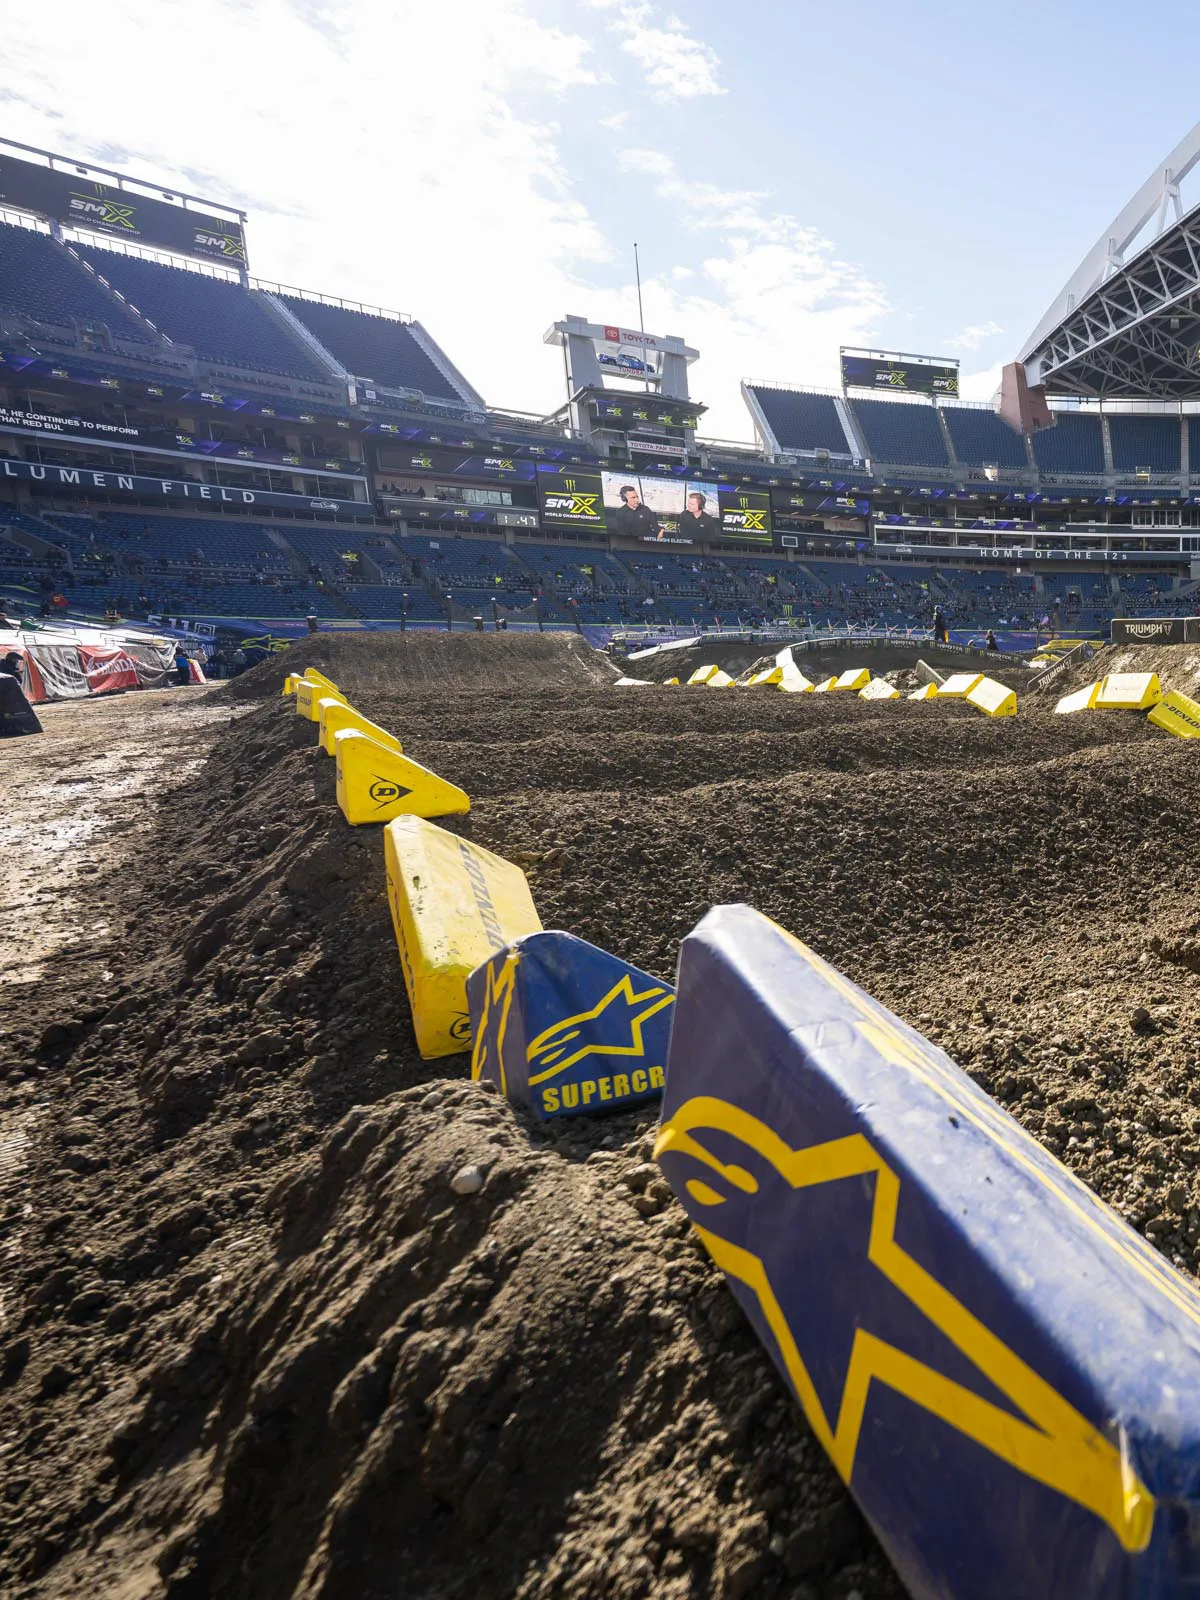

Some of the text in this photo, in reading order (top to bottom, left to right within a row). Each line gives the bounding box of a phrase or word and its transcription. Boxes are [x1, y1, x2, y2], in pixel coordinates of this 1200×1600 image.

[69, 199, 135, 229] SMX
[194, 234, 243, 258] SMX
[622, 332, 656, 346] TOYOTA
[875, 372, 907, 386] SMX
[11, 410, 139, 436] HE CONTINUES TO PERFORM
[22, 419, 43, 429] RED
[44, 422, 64, 431] BUL
[483, 457, 514, 470] SMX
[4, 462, 256, 504] LUMEN FIELD
[545, 496, 597, 516] SMX
[545, 511, 601, 521] WORLD CHAMPIONSHIP
[723, 512, 766, 530] SMX
[980, 549, 1023, 558] HOME
[1035, 551, 1052, 559] OF
[1104, 552, 1127, 560] 12s
[1125, 623, 1163, 638] TRIUMPH
[1038, 663, 1066, 688] TRIUMPH
[460, 844, 506, 950] DUNLOP
[542, 1066, 665, 1112] SUPERCR
